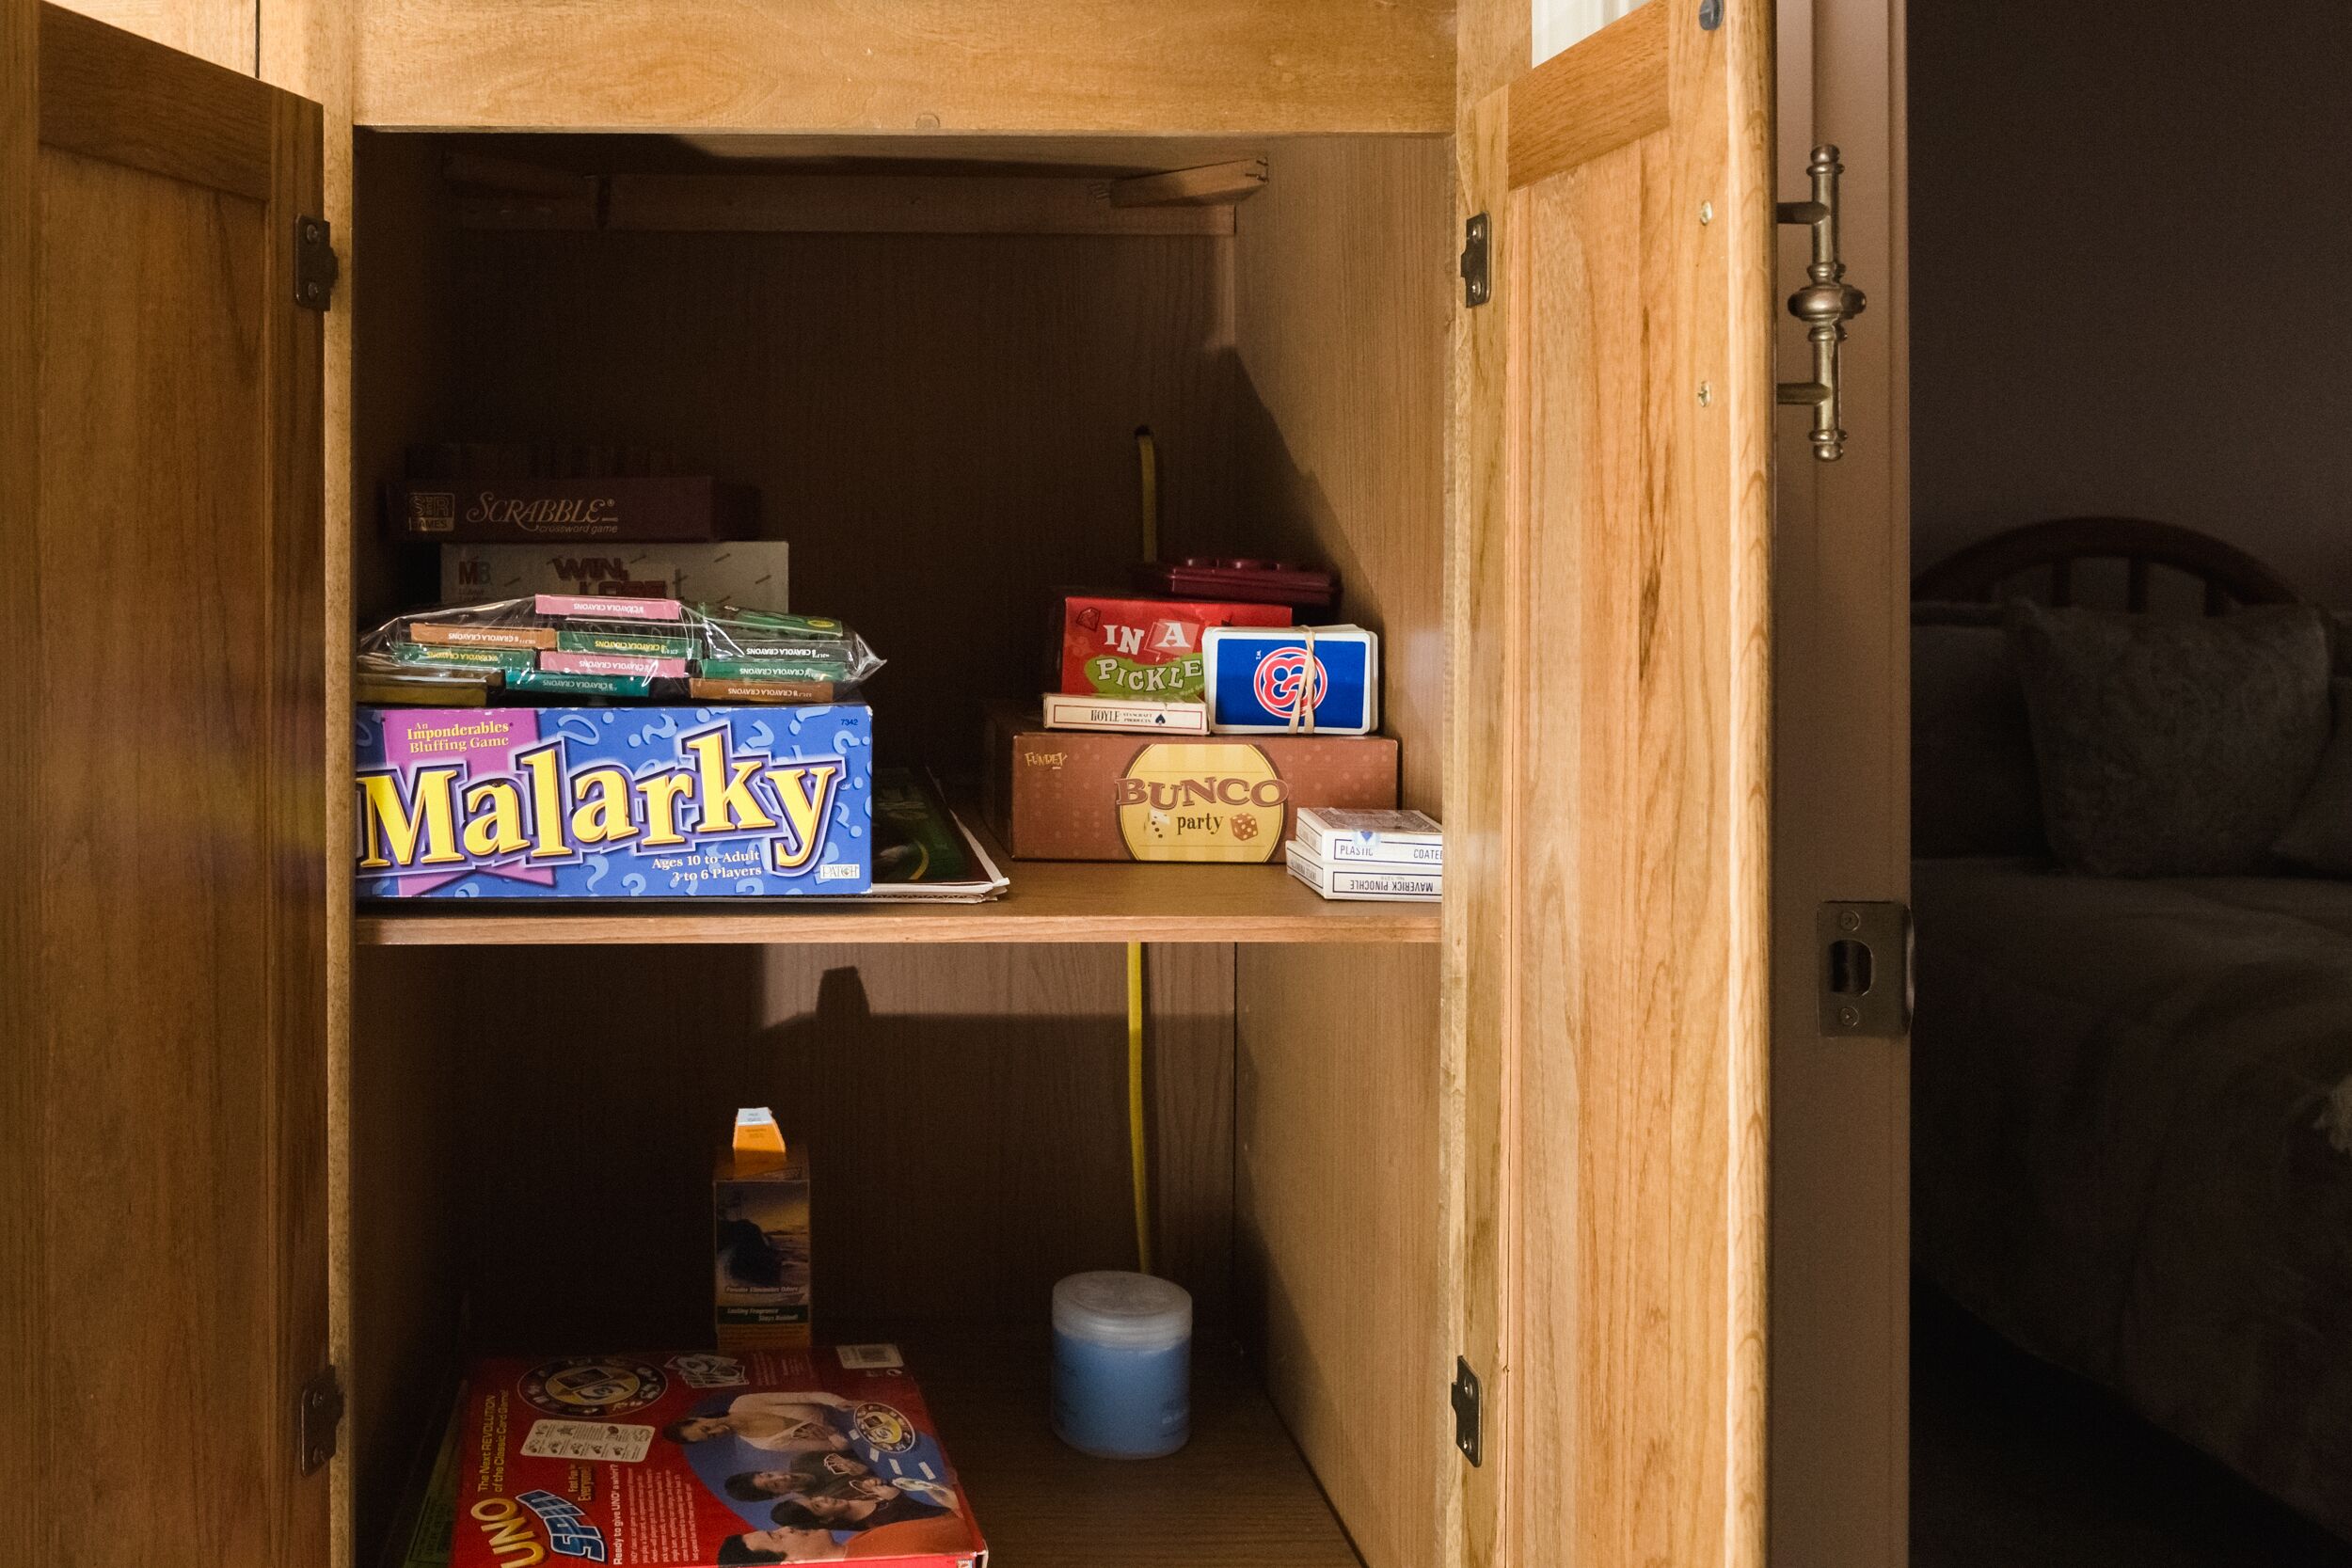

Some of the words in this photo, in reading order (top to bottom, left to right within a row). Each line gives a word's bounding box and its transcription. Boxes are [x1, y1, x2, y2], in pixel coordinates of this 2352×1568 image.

[537, 524, 591, 533] crossword
[591, 524, 618, 535] game
[573, 603, 606, 611] CRAYONS
[448, 632, 481, 641] CRAYONS
[481, 634, 514, 642] CRAYOLA
[1103, 625, 1145, 656] IN
[1154, 622, 1191, 648] A
[628, 642, 660, 652] CRAYOLA
[746, 647, 778, 656] CRAYONS
[780, 648, 811, 657] CRAYOLA
[579, 660, 612, 669] CRAYONS
[739, 667, 771, 675] CRAYONS
[772, 668, 804, 676] CRAYOLA
[1096, 658, 1202, 692] PICKLE
[543, 679, 575, 689] CRAYONS
[576, 681, 608, 689] CRAYOLA
[727, 688, 760, 696] CRAYONS
[761, 689, 792, 697] CRAYOLA
[1090, 709, 1120, 722] HOYLE
[406, 721, 509, 742] Imponderables
[414, 721, 428, 731] An
[409, 737, 468, 754] Bluffing
[469, 736, 509, 750] Game
[355, 726, 840, 872] Malarky
[1115, 776, 1289, 810] BUNCO
[1176, 812, 1225, 835] party
[651, 857, 683, 871] Ages
[686, 855, 701, 866] 10
[704, 854, 719, 864] to
[722, 849, 760, 863] Adult
[672, 870, 680, 882] 3
[683, 869, 697, 881] to
[700, 869, 708, 880] 6
[711, 866, 762, 880] Players
[1350, 879, 1389, 892] PINOCHLE
[1392, 879, 1434, 893] MAVERICK
[482, 1394, 496, 1450] REVOLUTION
[496, 1414, 507, 1434] Card
[494, 1435, 506, 1465] Classic
[480, 1451, 491, 1474] Next
[493, 1467, 504, 1482] the
[477, 1475, 489, 1492] The
[493, 1481, 503, 1493] of
[612, 1511, 624, 1527] give
[470, 1497, 547, 1568] UNO
[612, 1527, 622, 1536] to
[612, 1538, 625, 1565] Ready
